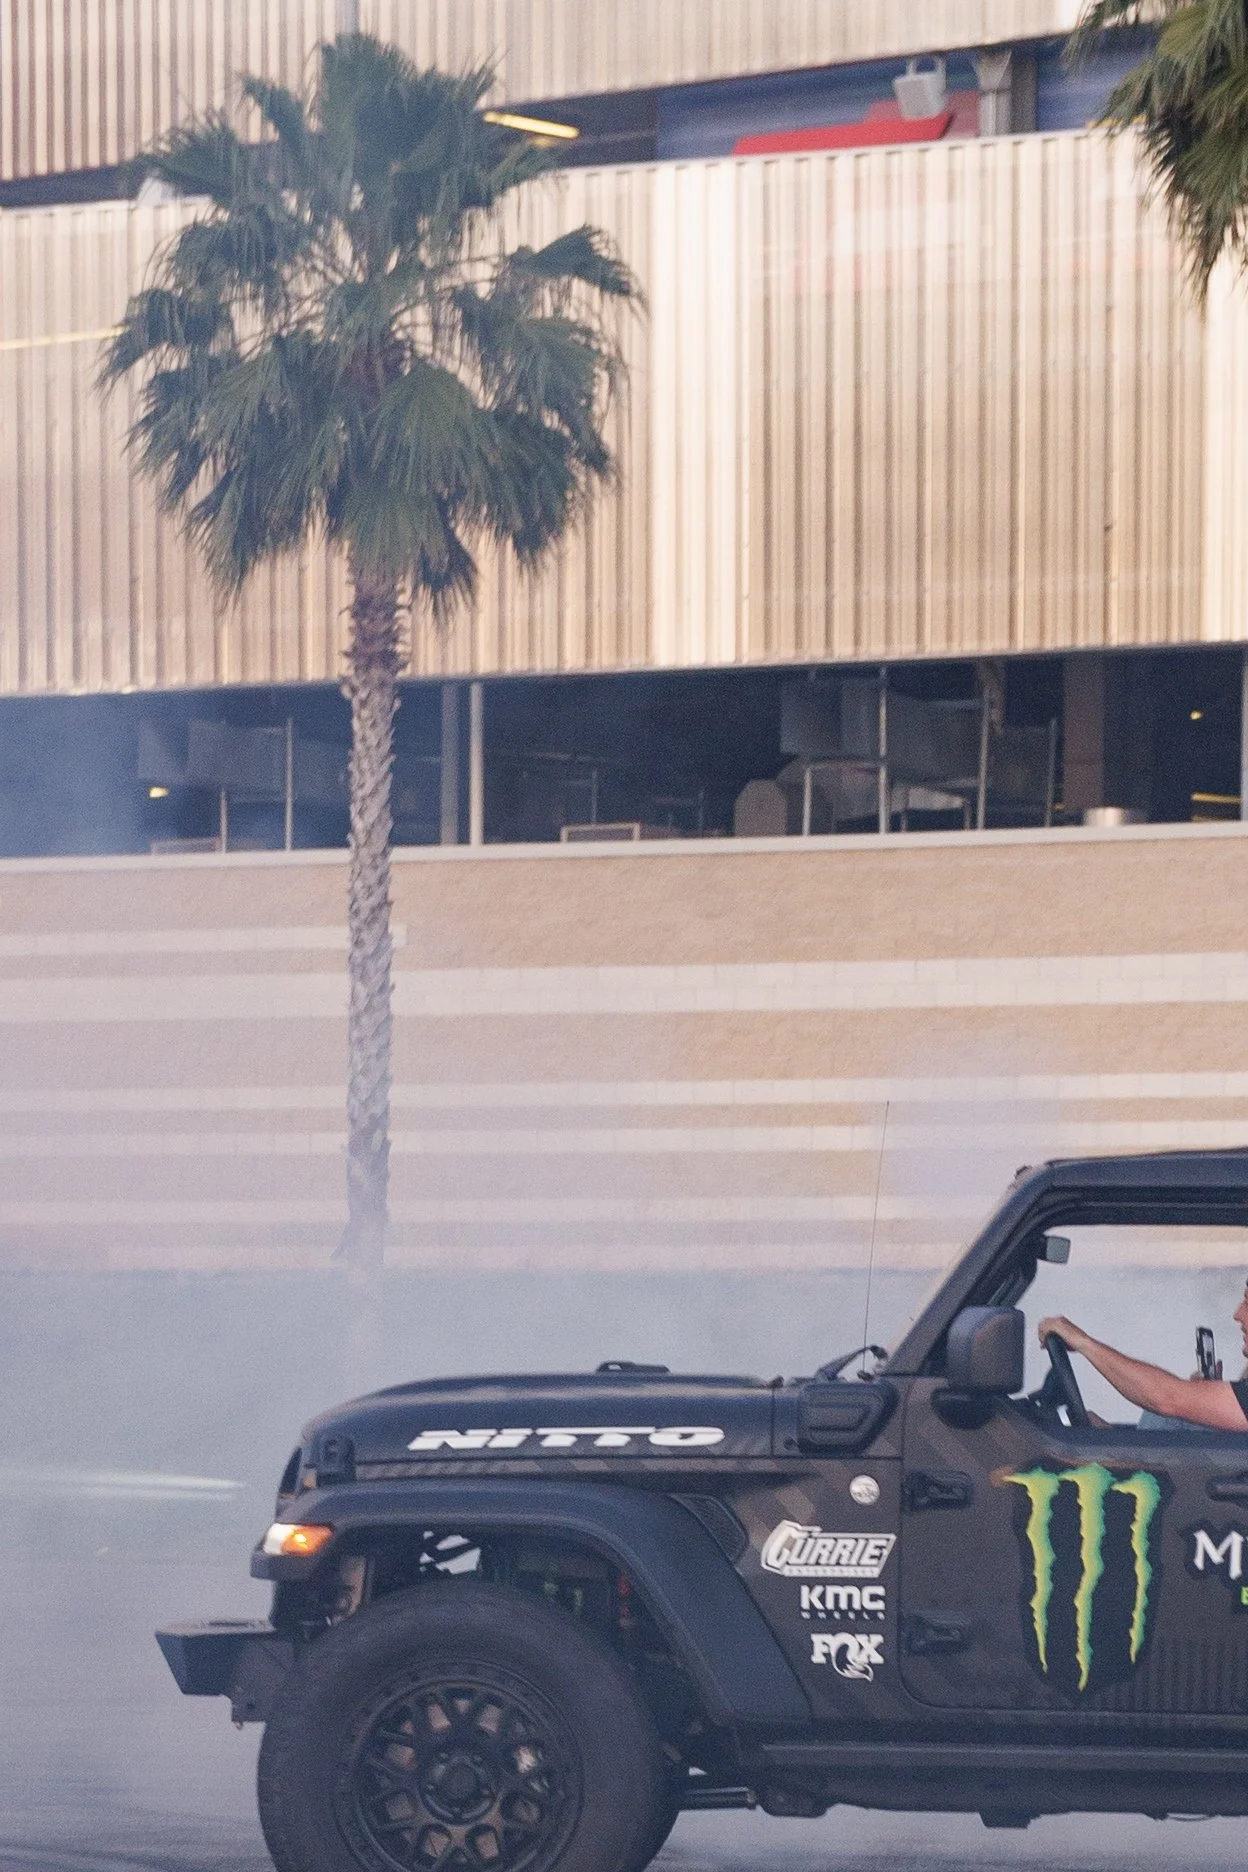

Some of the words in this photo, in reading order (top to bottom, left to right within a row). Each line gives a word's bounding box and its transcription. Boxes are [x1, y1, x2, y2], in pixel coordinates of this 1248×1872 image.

[408, 1427, 725, 1451] NITTO
[765, 1523, 889, 1568] CURRIE
[801, 1585, 886, 1610] KMC
[811, 1632, 885, 1680] FOX
